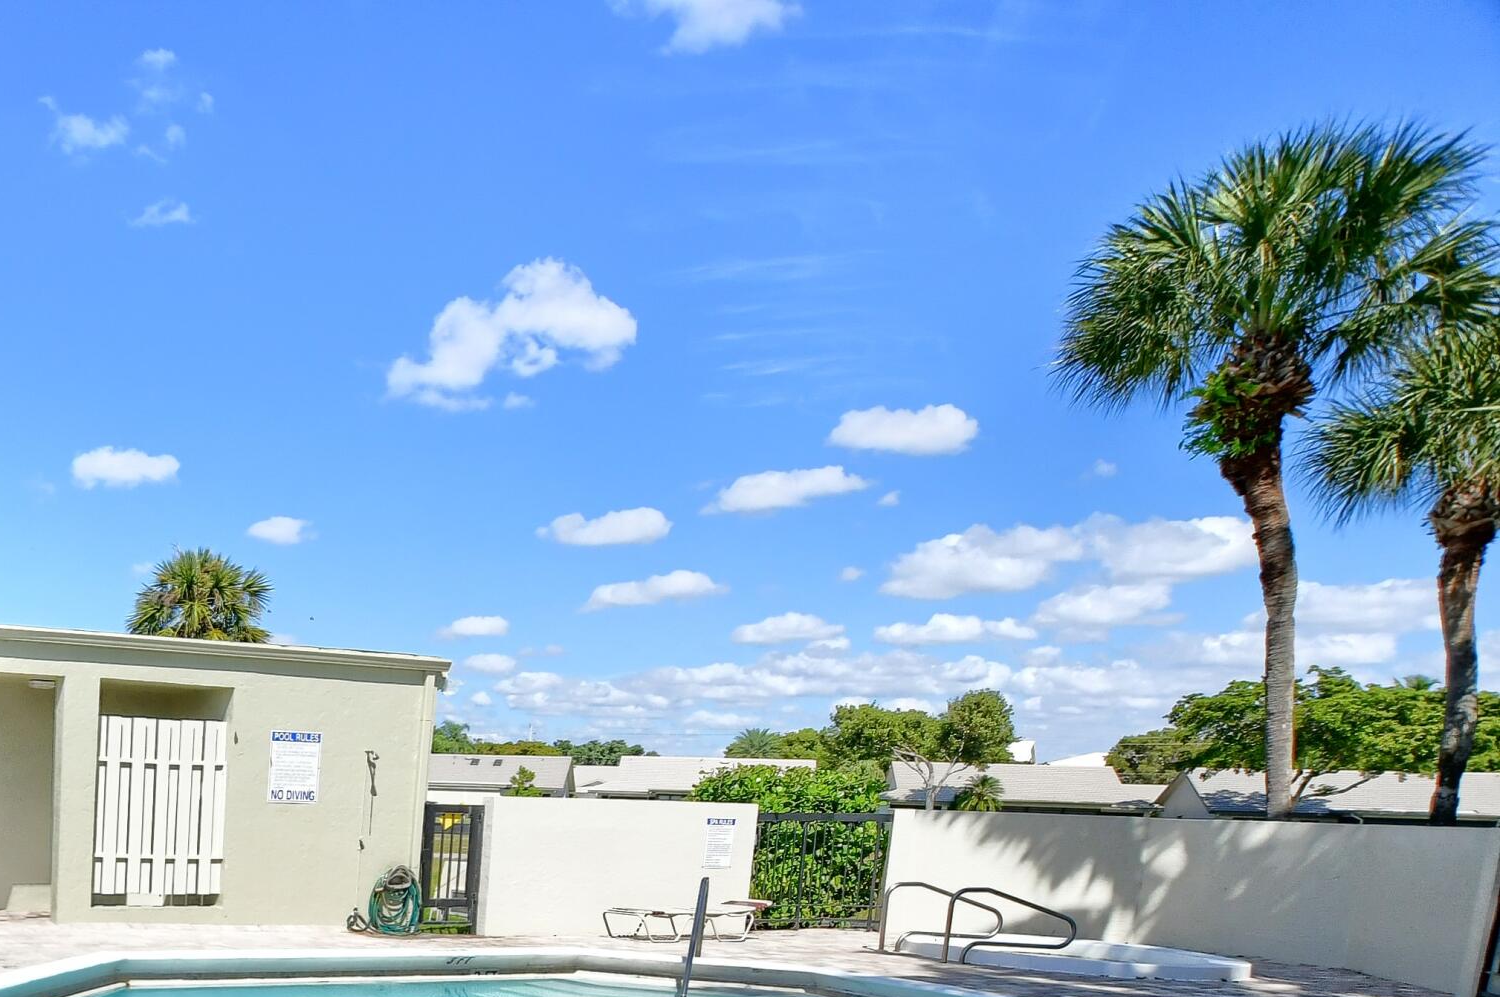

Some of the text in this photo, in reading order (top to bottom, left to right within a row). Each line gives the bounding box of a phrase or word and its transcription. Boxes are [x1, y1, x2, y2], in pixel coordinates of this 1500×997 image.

[274, 732, 319, 742] POOL RULES
[270, 789, 315, 801] NO DIVING
